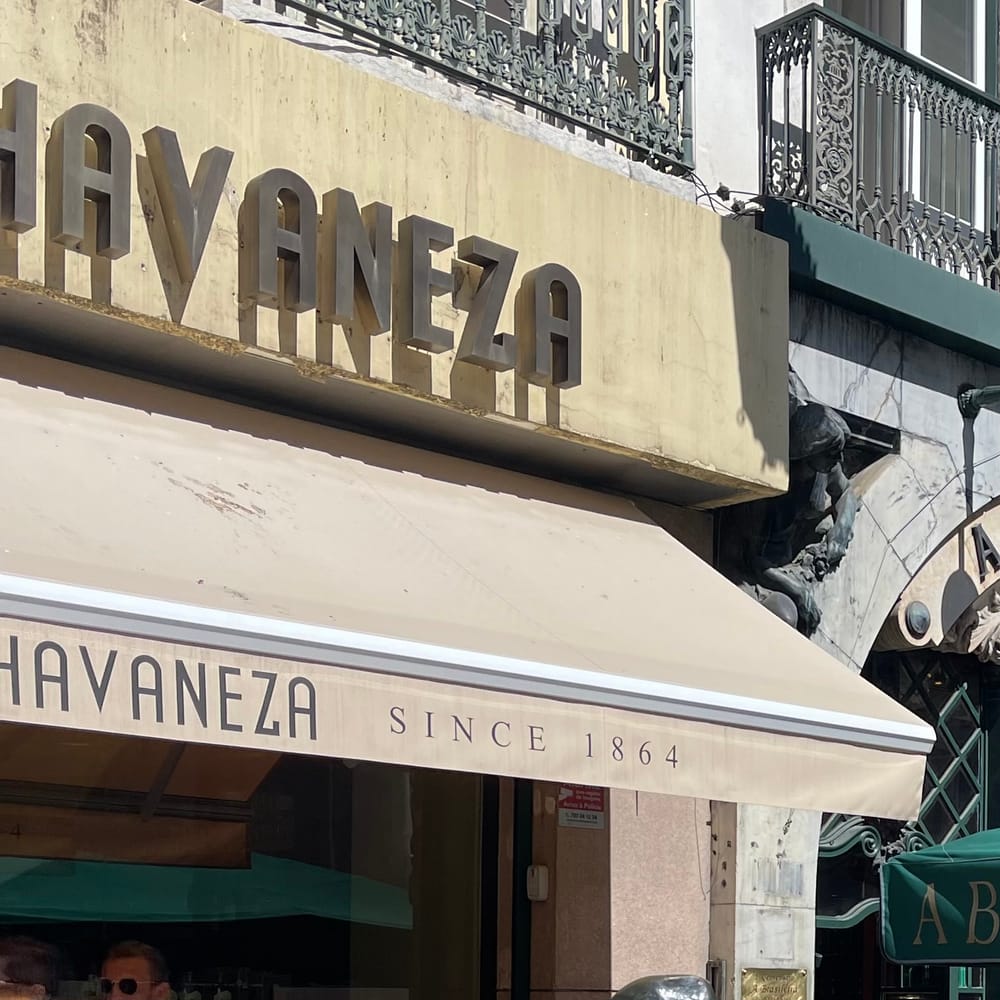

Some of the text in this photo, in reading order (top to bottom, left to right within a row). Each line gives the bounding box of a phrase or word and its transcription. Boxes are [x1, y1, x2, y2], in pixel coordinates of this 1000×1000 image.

[388, 706, 547, 752] SINCE
[584, 732, 680, 769] 1864
[912, 883, 948, 946] A
